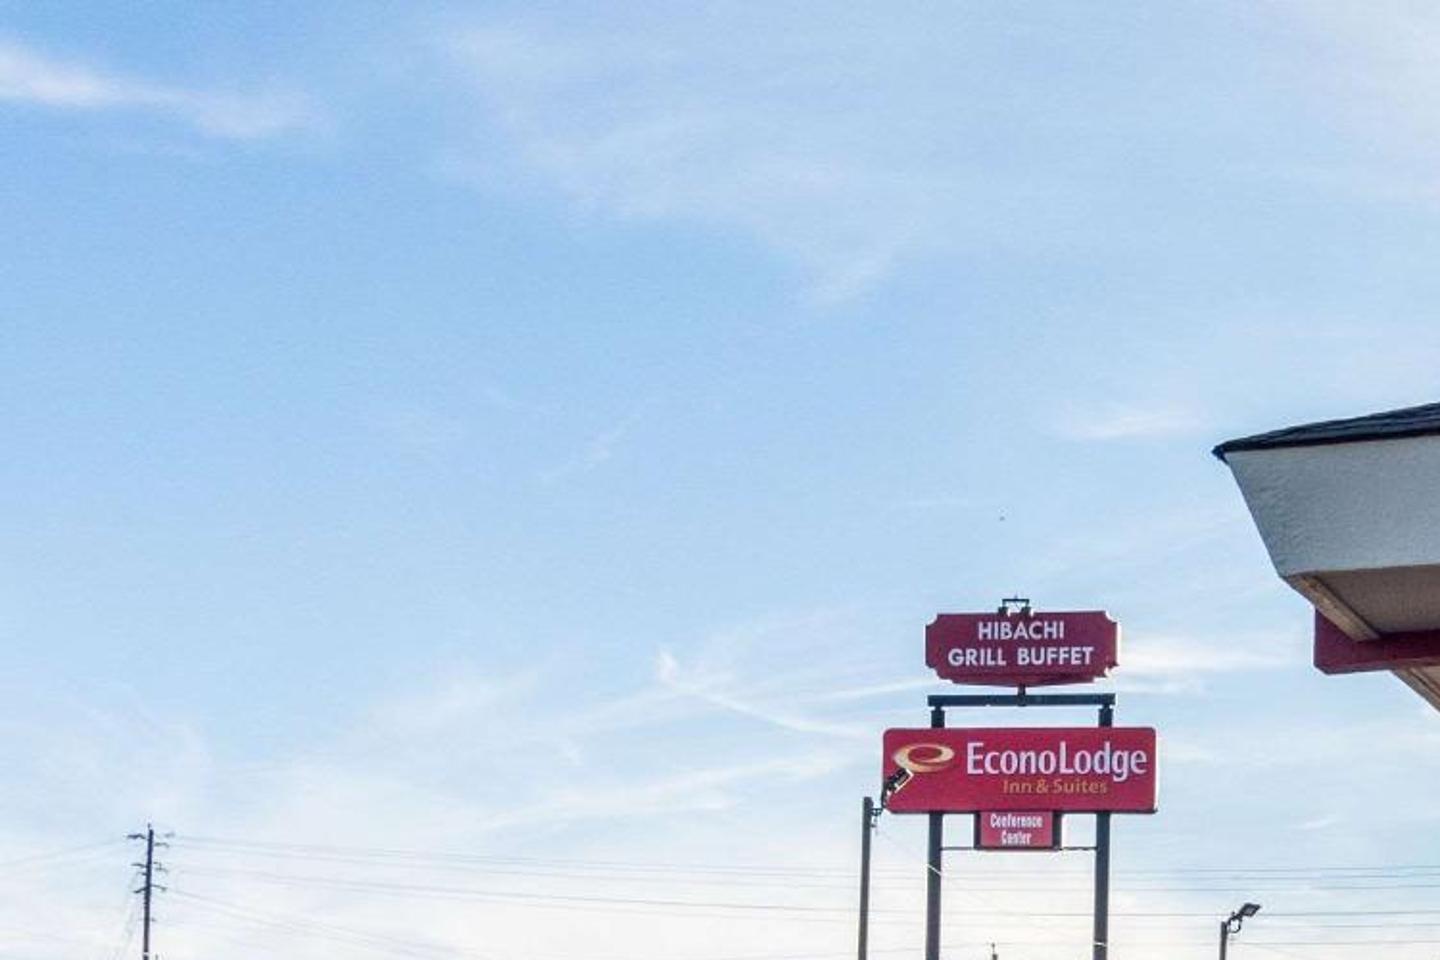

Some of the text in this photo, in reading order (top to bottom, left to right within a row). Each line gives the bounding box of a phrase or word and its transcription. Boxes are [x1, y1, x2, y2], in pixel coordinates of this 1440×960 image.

[978, 621, 1065, 641] HIBACHI
[948, 646, 1094, 667] GRILL BUFFET
[966, 741, 1147, 782] EconoLodge
[1003, 779, 1108, 793] Inn & Suites
[990, 812, 1043, 828] Conference
[1001, 829, 1032, 845] Center
